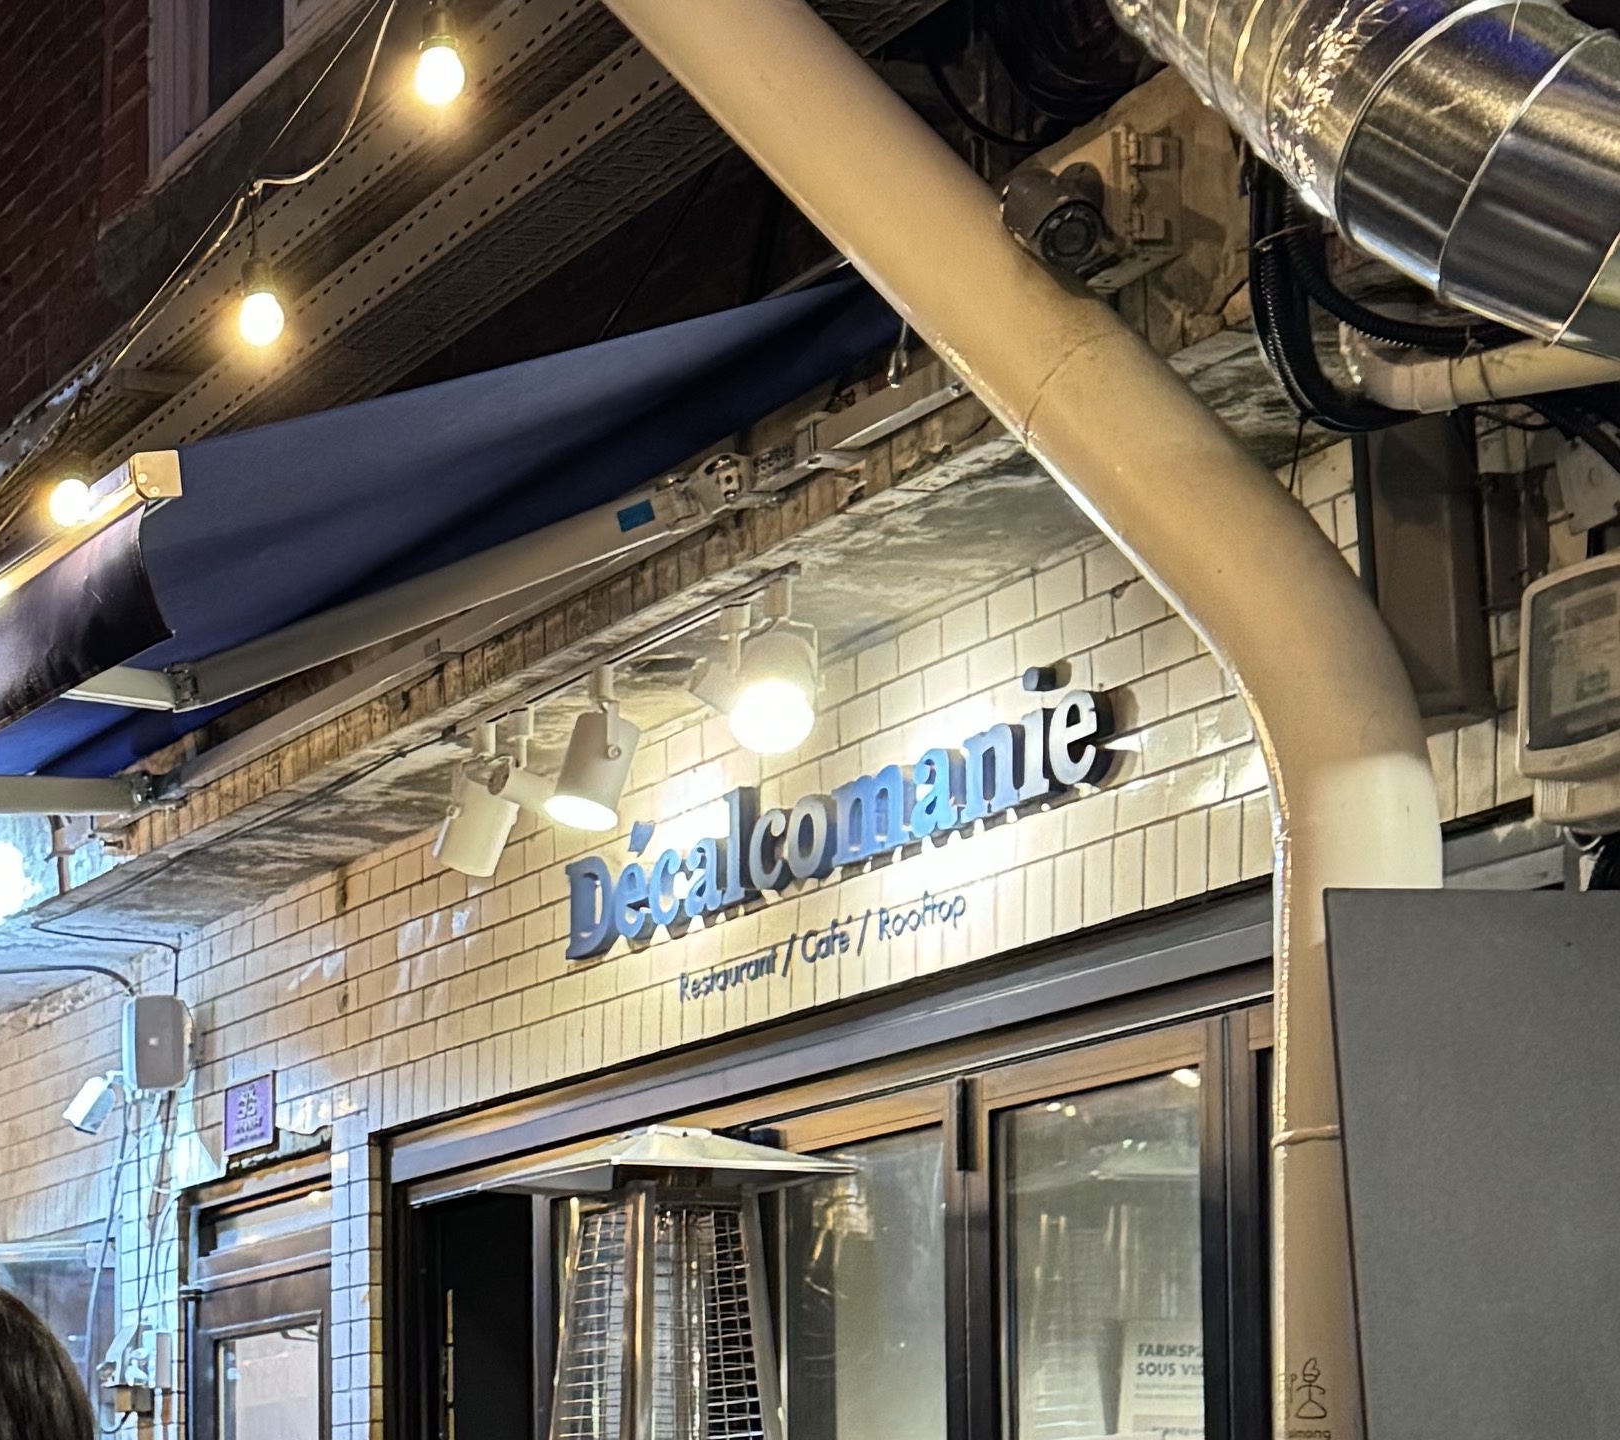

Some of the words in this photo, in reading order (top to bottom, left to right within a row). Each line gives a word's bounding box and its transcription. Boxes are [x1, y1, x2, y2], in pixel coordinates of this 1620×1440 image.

[564, 665, 1112, 961] Décalcomanie
[679, 947, 778, 1003] Restaurant
[801, 915, 852, 964] Café
[878, 889, 967, 942] Rooftop
[1136, 1362, 1176, 1377] SOUS
